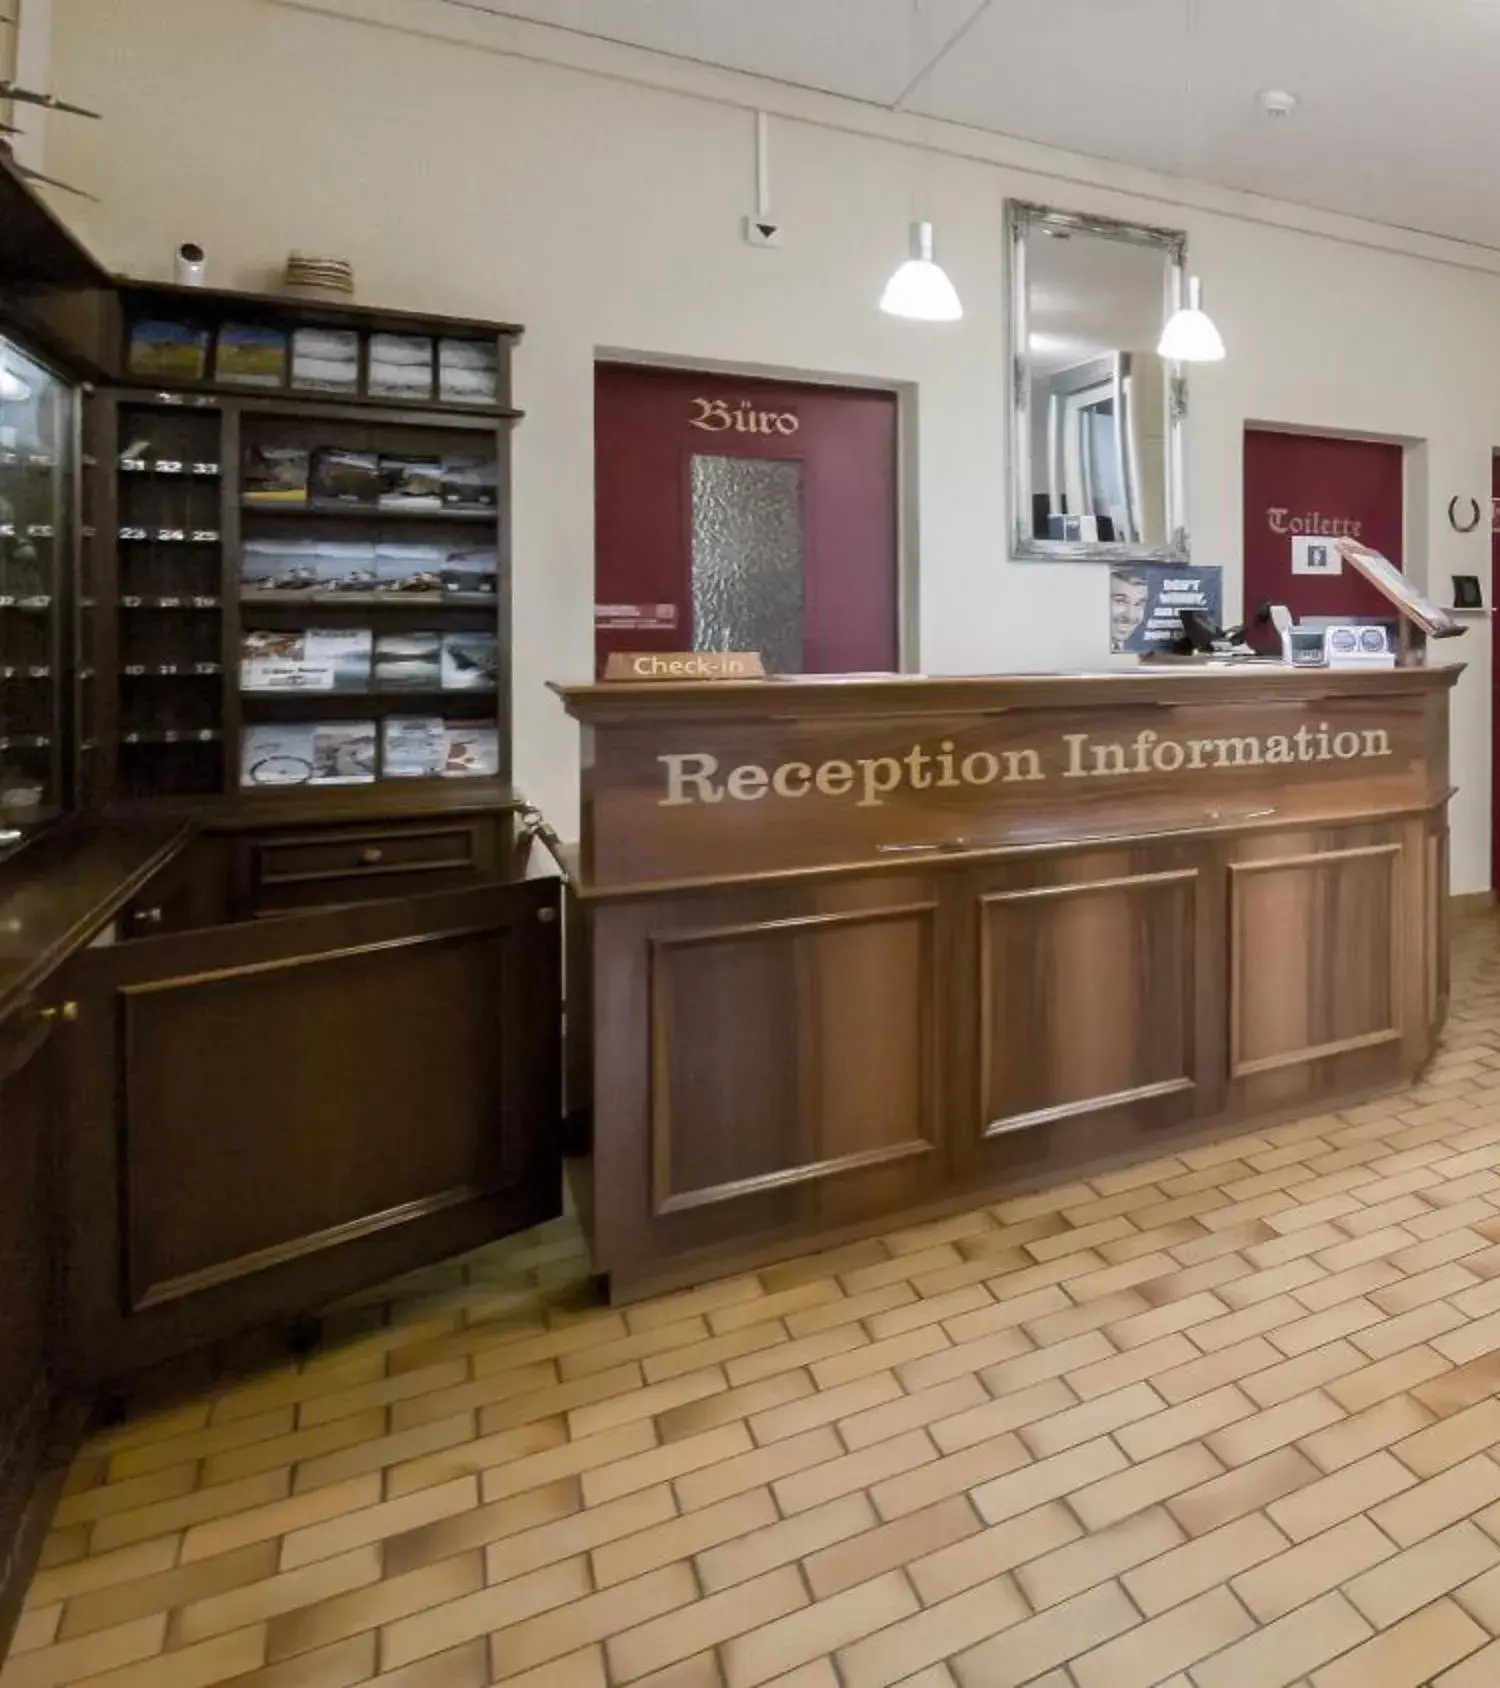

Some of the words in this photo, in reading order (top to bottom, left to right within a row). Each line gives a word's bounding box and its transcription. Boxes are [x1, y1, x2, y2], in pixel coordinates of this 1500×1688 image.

[688, 397, 800, 436] Büro
[1266, 507, 1362, 537] Toilette
[633, 656, 744, 676] Check-in
[657, 740, 1045, 807] Reception
[1062, 722, 1393, 778] Information
